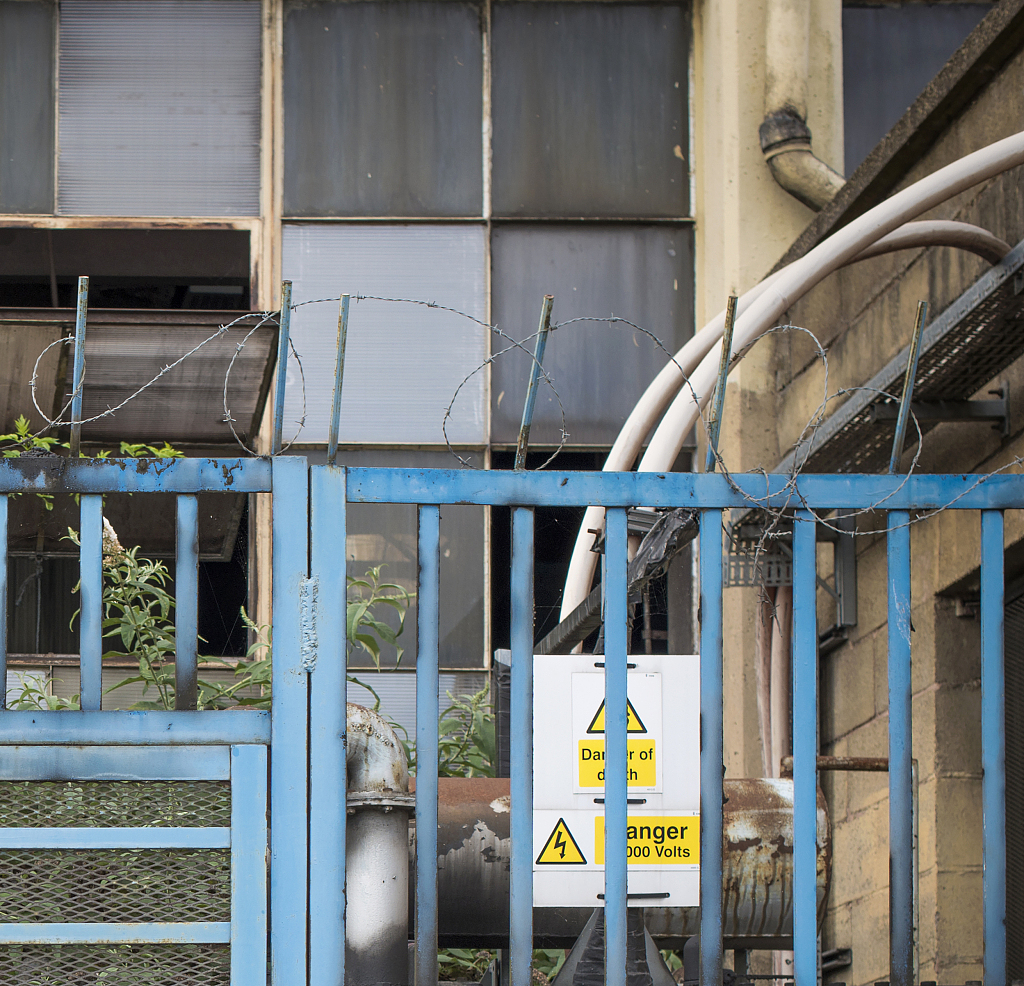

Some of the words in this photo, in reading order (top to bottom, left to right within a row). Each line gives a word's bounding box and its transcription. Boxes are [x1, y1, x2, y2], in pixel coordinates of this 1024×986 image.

[639, 748, 653, 760] of
[626, 826, 688, 844] anger
[655, 846, 690, 857] Volts
